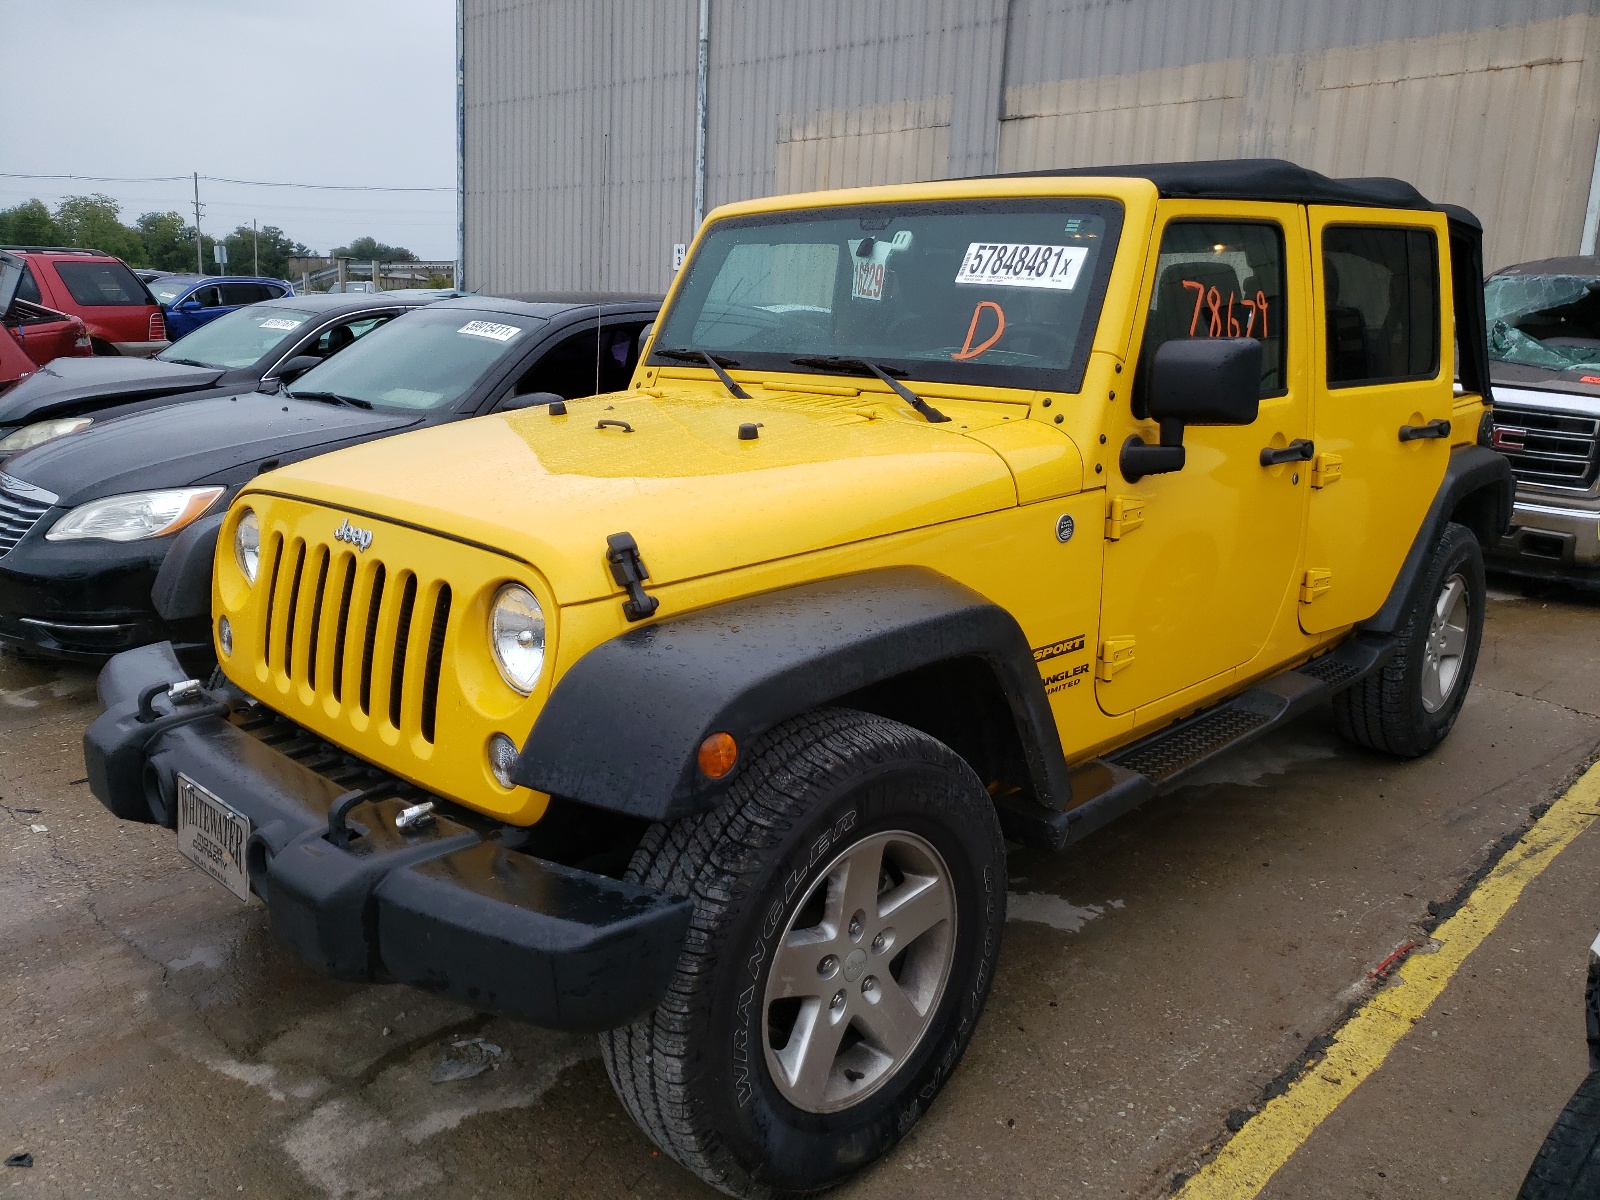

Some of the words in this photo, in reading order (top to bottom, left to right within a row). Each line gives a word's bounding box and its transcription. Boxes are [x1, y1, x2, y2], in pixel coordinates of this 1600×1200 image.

[951, 301, 1006, 360] D
[1182, 280, 1269, 338] 78679
[334, 517, 373, 553] Jeep
[1033, 639, 1083, 660] SPORT
[180, 785, 243, 875] WHITEWATER
[733, 810, 857, 1108] WRANGLER
